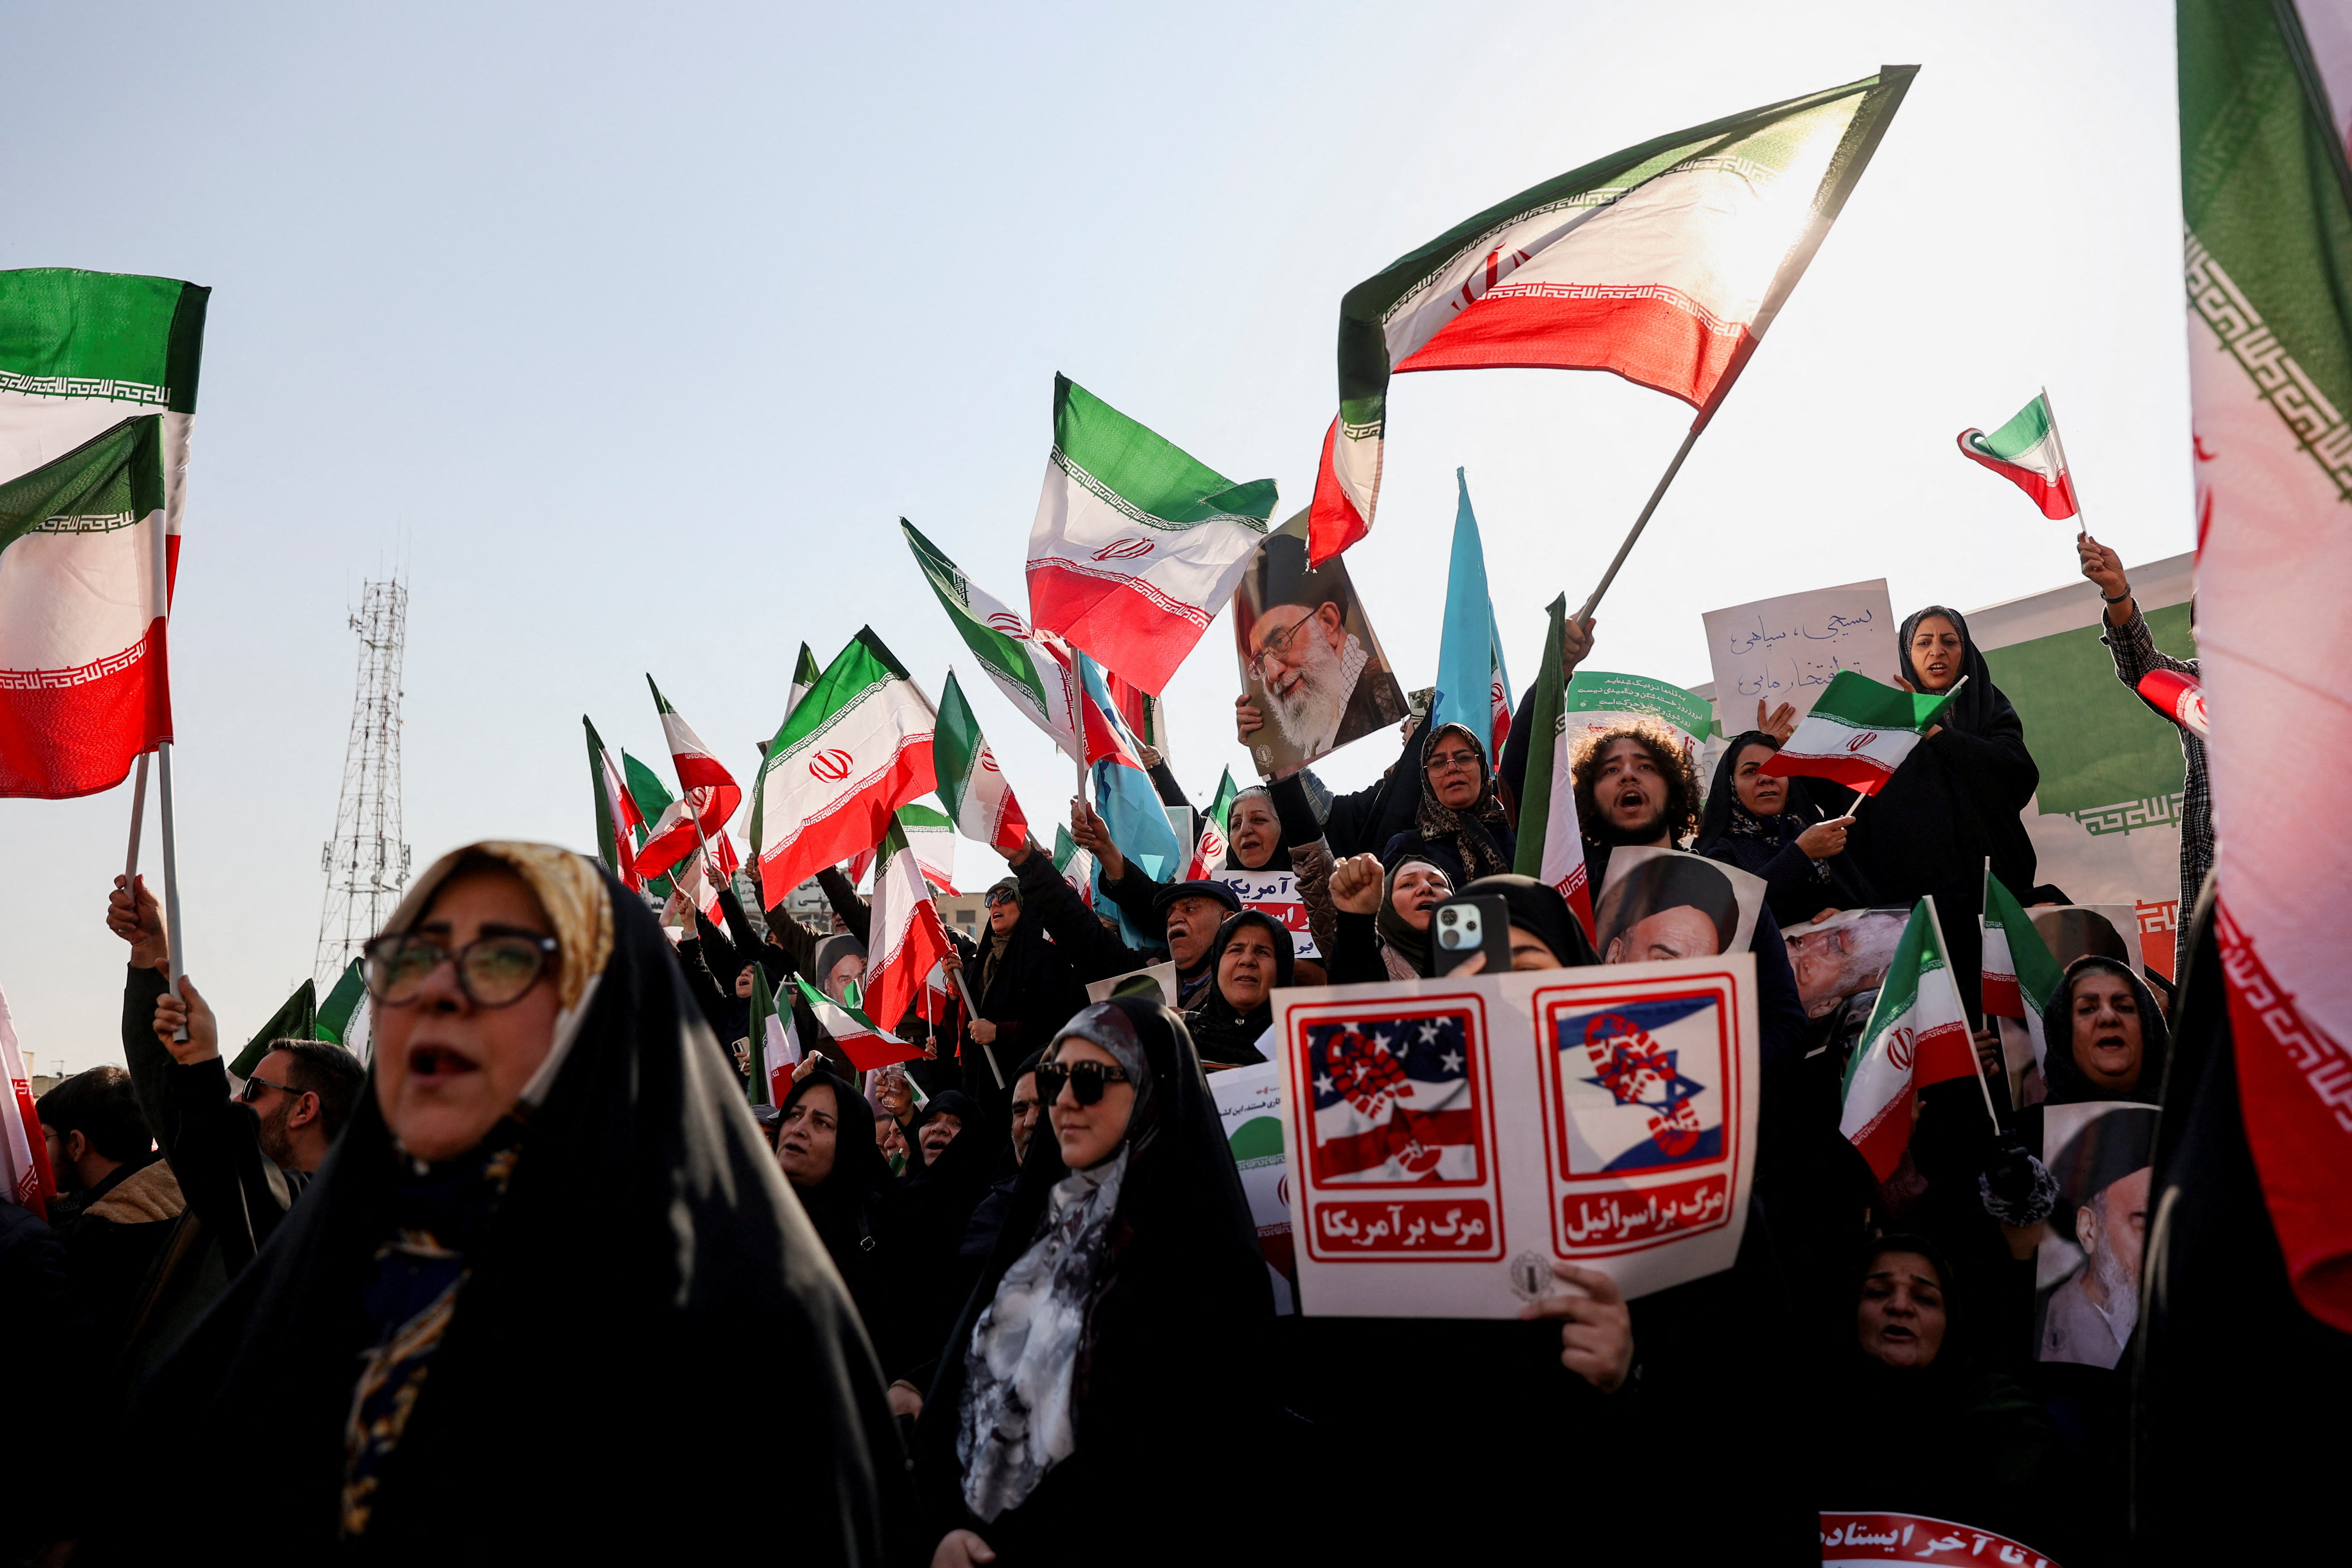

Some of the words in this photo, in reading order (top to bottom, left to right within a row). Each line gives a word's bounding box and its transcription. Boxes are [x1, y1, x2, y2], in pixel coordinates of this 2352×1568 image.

[1632, 680, 1660, 690] نزدیک
[1615, 699, 1640, 707] حرکت
[1656, 696, 1677, 706] خسته
[1677, 703, 1688, 713] روز
[1666, 710, 1680, 721] شوق
[1688, 709, 1703, 720] امروز
[1680, 717, 1691, 727] روز
[1294, 941, 1314, 955] بر
[1680, 1185, 1724, 1220] مرگ
[1567, 1194, 1657, 1241] اسرائیل
[1655, 1199, 1678, 1232] بر
[1322, 1204, 1404, 1246] آمریکا
[1402, 1216, 1426, 1246] بر
[1430, 1208, 1485, 1245] مرگ
[1915, 1530, 1994, 1556] آخر
